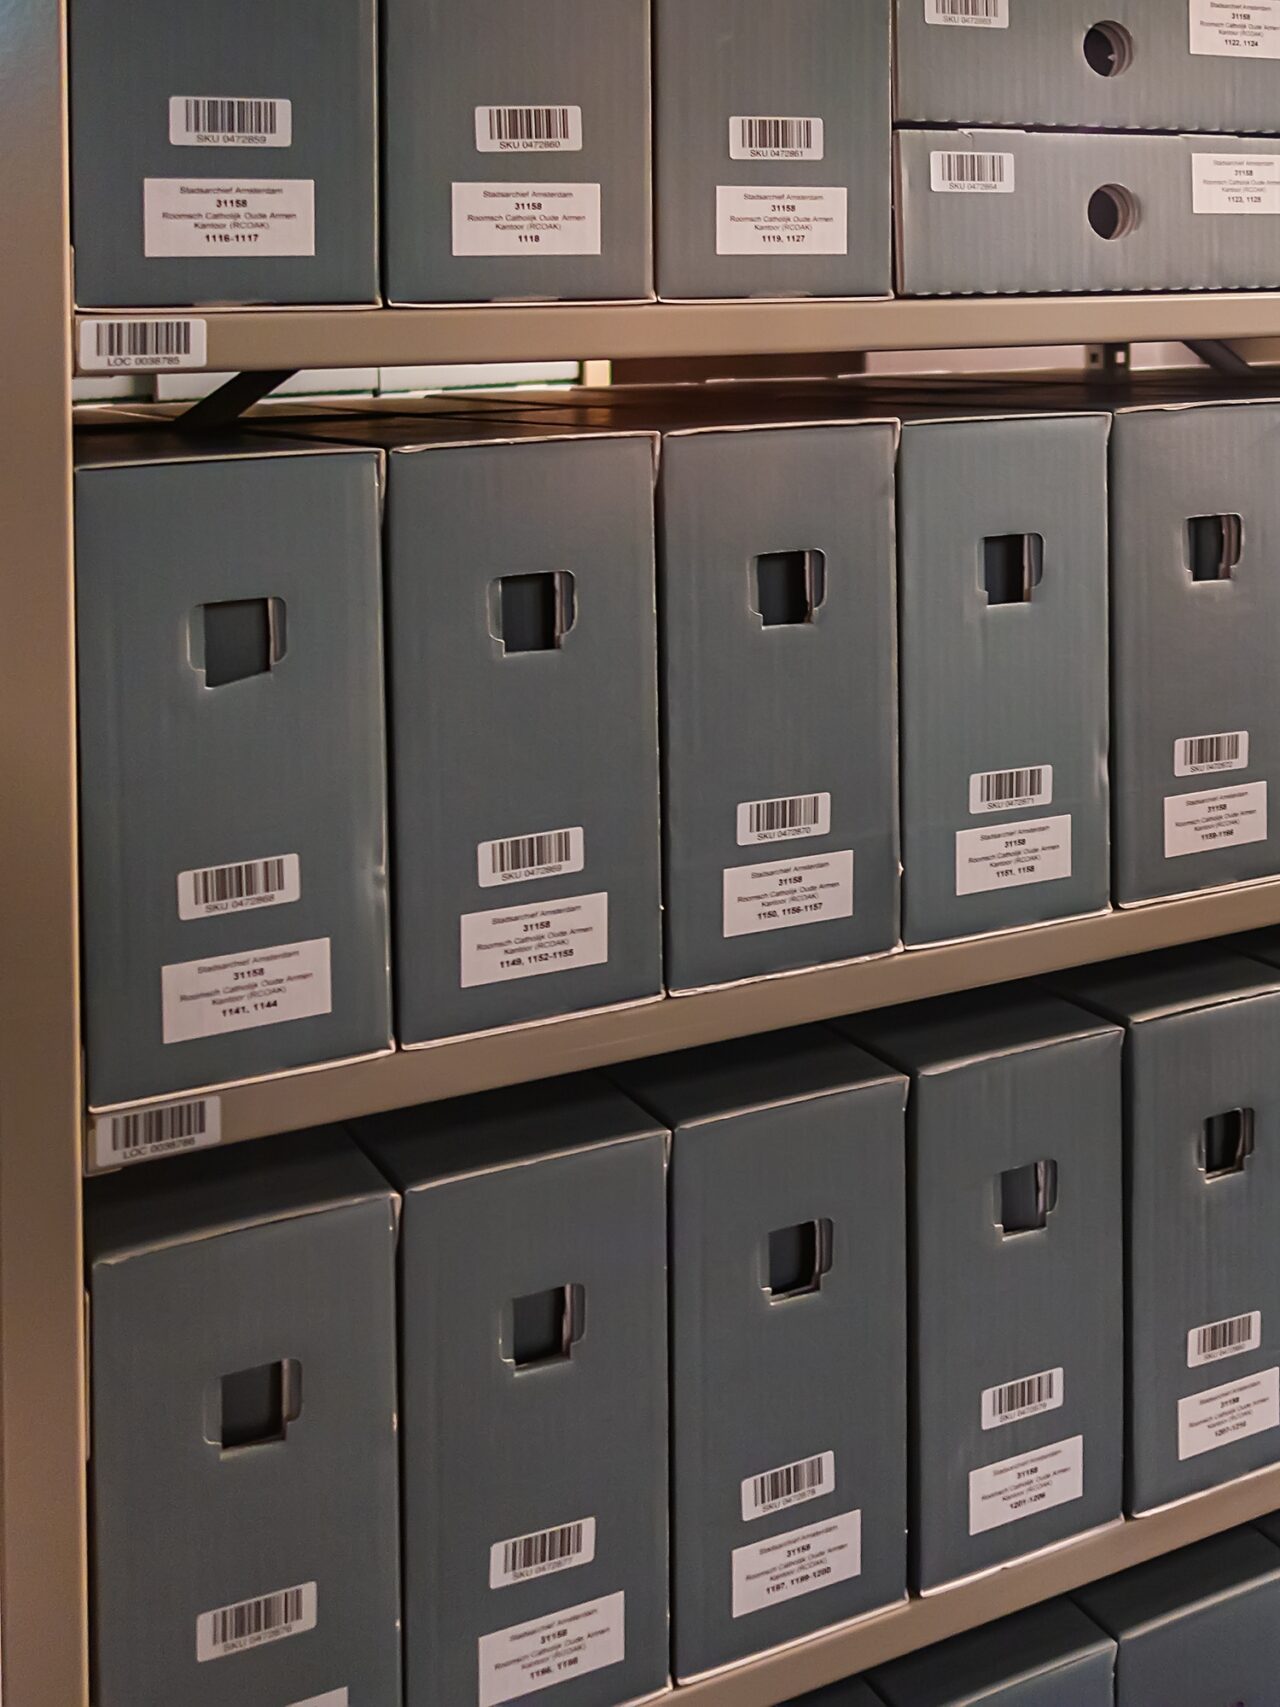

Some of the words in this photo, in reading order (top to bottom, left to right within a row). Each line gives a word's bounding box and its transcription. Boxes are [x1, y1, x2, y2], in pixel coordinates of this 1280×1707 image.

[222, 135, 267, 143] 0472859
[499, 141, 519, 149] SKU
[522, 141, 561, 149] 0472860
[750, 150, 768, 158] SKU
[770, 150, 803, 158] 0472861
[217, 199, 247, 208] 31158
[515, 202, 542, 210] 31158
[206, 234, 258, 242] 1116-1117
[107, 358, 131, 366] LOC
[134, 357, 181, 365] 0038785
[987, 801, 1002, 810] SKU
[757, 832, 775, 841] SKU
[1005, 839, 1026, 848] 31158
[751, 868, 791, 878] Stadsarchief
[793, 862, 829, 871] Amsterdam
[996, 869, 1013, 877] 1151,
[1018, 865, 1034, 873] 1158
[501, 871, 522, 881] SKU
[779, 876, 802, 886] 31158
[737, 893, 768, 902] Roomsch
[205, 902, 228, 913] SKU
[761, 899, 786, 907] Kantoor
[492, 912, 538, 925] Stadsarchief
[540, 906, 581, 916] Amsterdam
[758, 910, 778, 919] 1150,
[782, 903, 822, 915] 1156-1157
[523, 921, 550, 932] 31158
[477, 940, 512, 950] Roomsch
[514, 935, 545, 944] Catholijk
[504, 946, 532, 954] Kantoor
[198, 959, 249, 974] Stadsarchief
[252, 951, 299, 963] Amsterdam
[500, 958, 523, 968] 1149,
[528, 949, 573, 963] 1152-1155
[234, 968, 264, 980] 31158
[180, 989, 220, 1001] Roomsch
[223, 983, 258, 994] Catholijk
[261, 978, 284, 987] Oude
[286, 973, 312, 981] Armen
[212, 995, 245, 1005] Kantoor
[222, 1006, 249, 1016] 1141,
[254, 1000, 277, 1010] 1144
[122, 1146, 147, 1160] LOC
[1017, 1467, 1038, 1479] 31158
[787, 1544, 810, 1557] 31158
[541, 1629, 567, 1644] 31158
